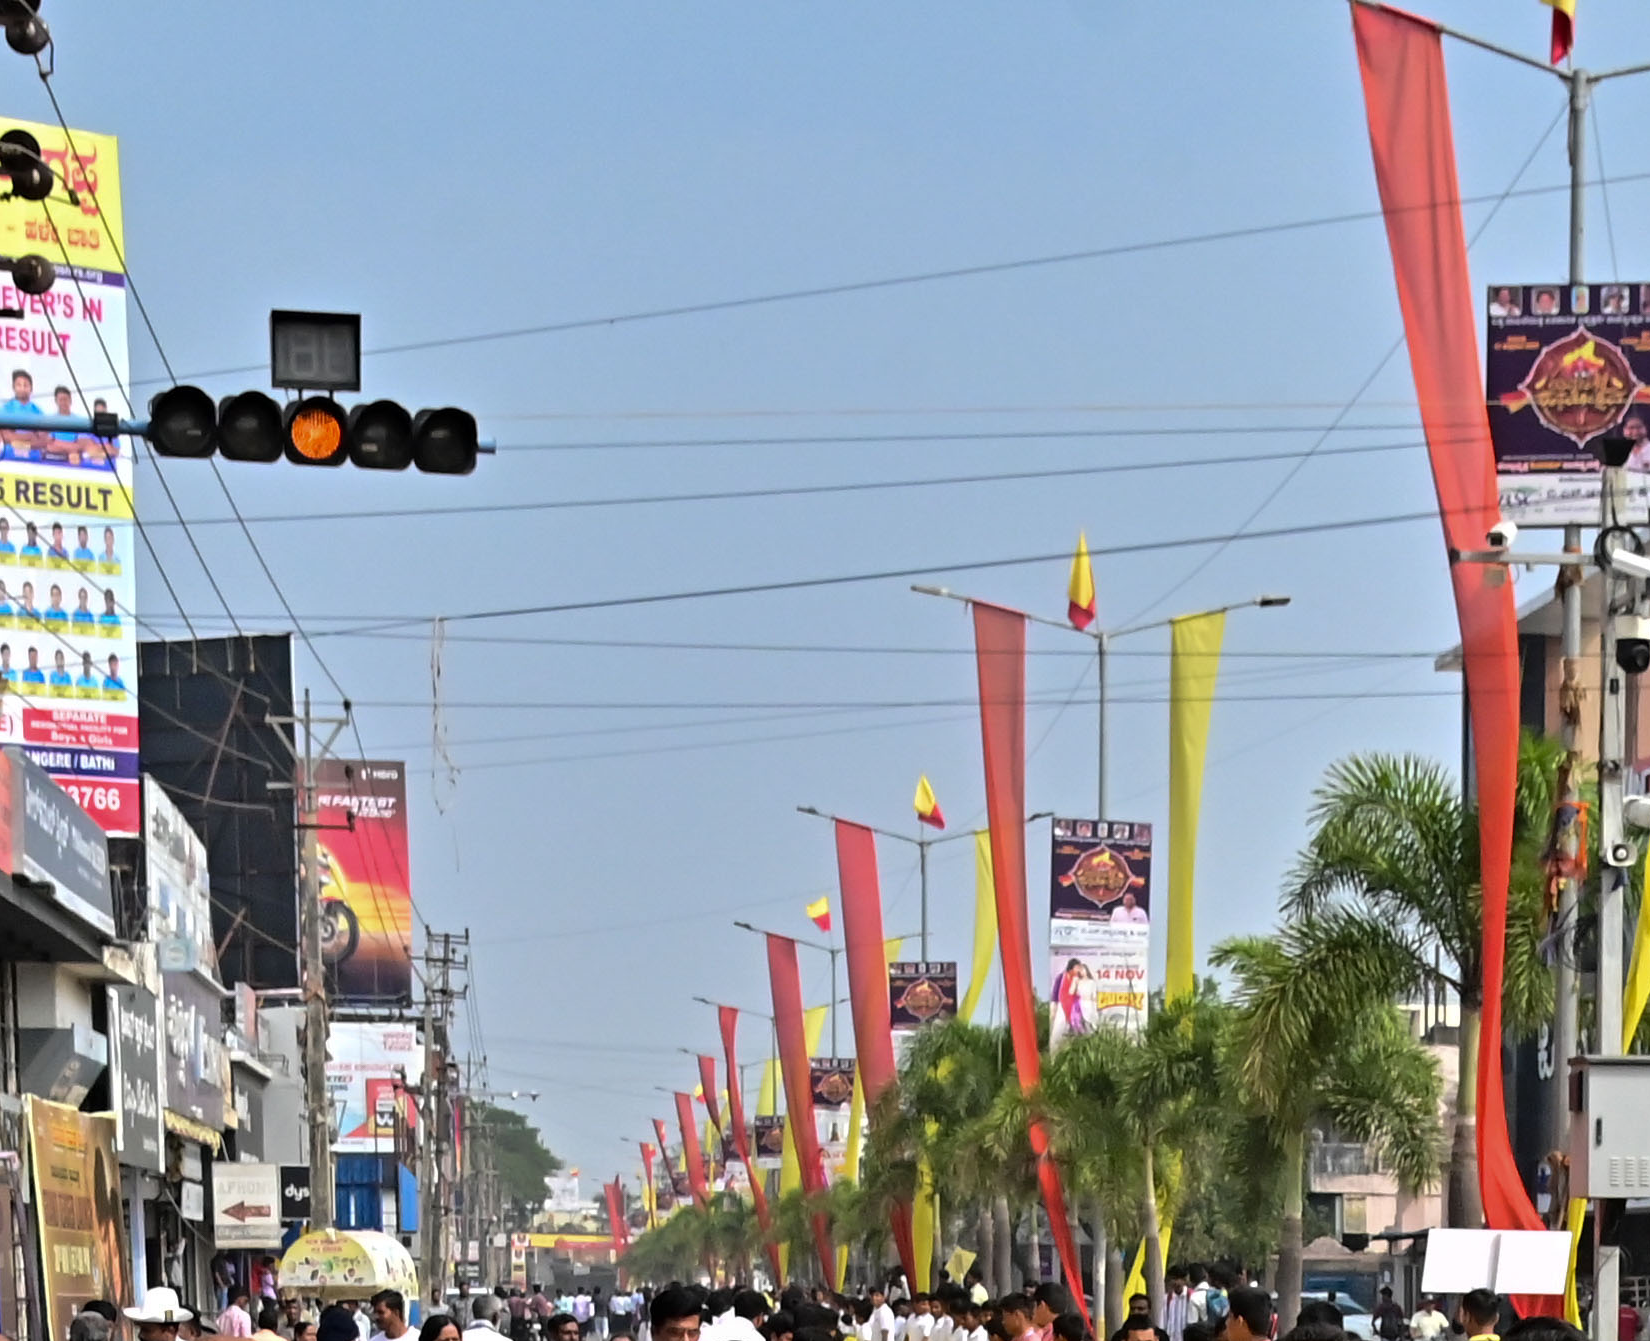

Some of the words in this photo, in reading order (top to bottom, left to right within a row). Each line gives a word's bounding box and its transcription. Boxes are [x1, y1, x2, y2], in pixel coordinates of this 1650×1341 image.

[83, 297, 103, 323] IN
[16, 479, 112, 512] RESULT
[1115, 969, 1144, 981] NOV
[284, 1183, 311, 1202] dys
